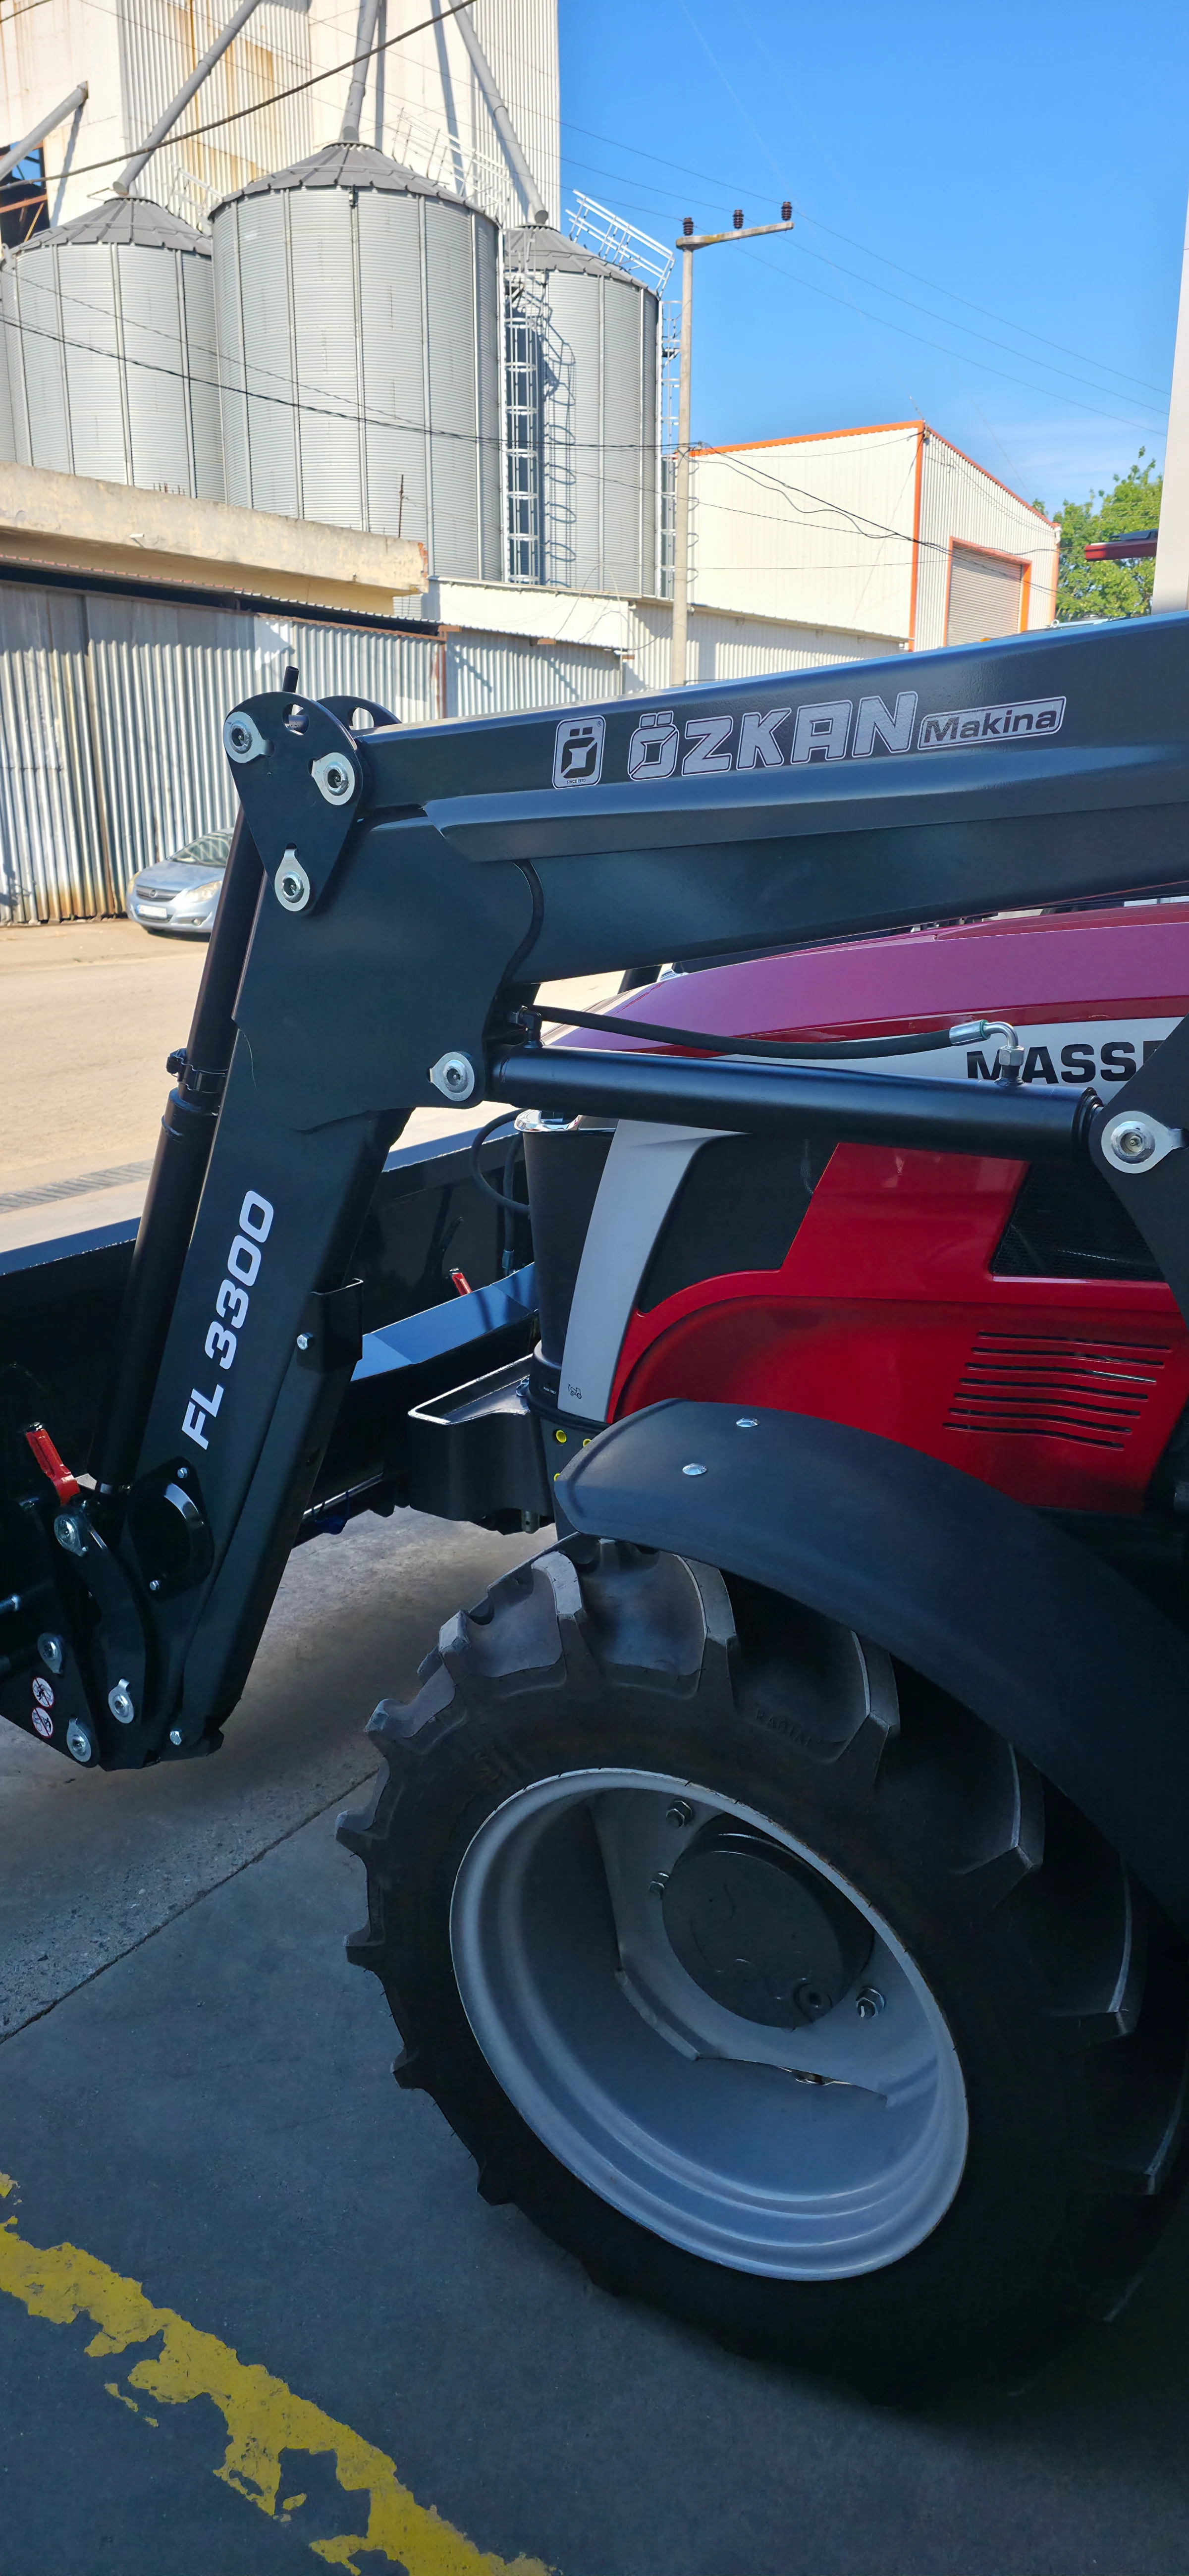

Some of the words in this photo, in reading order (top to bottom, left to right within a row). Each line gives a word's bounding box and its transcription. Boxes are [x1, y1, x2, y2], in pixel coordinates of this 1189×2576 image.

[627, 691, 918, 781] ÖZKAN
[924, 710, 1057, 743] Makina
[181, 1384, 224, 1450] FL
[205, 1190, 274, 1370] 3300
